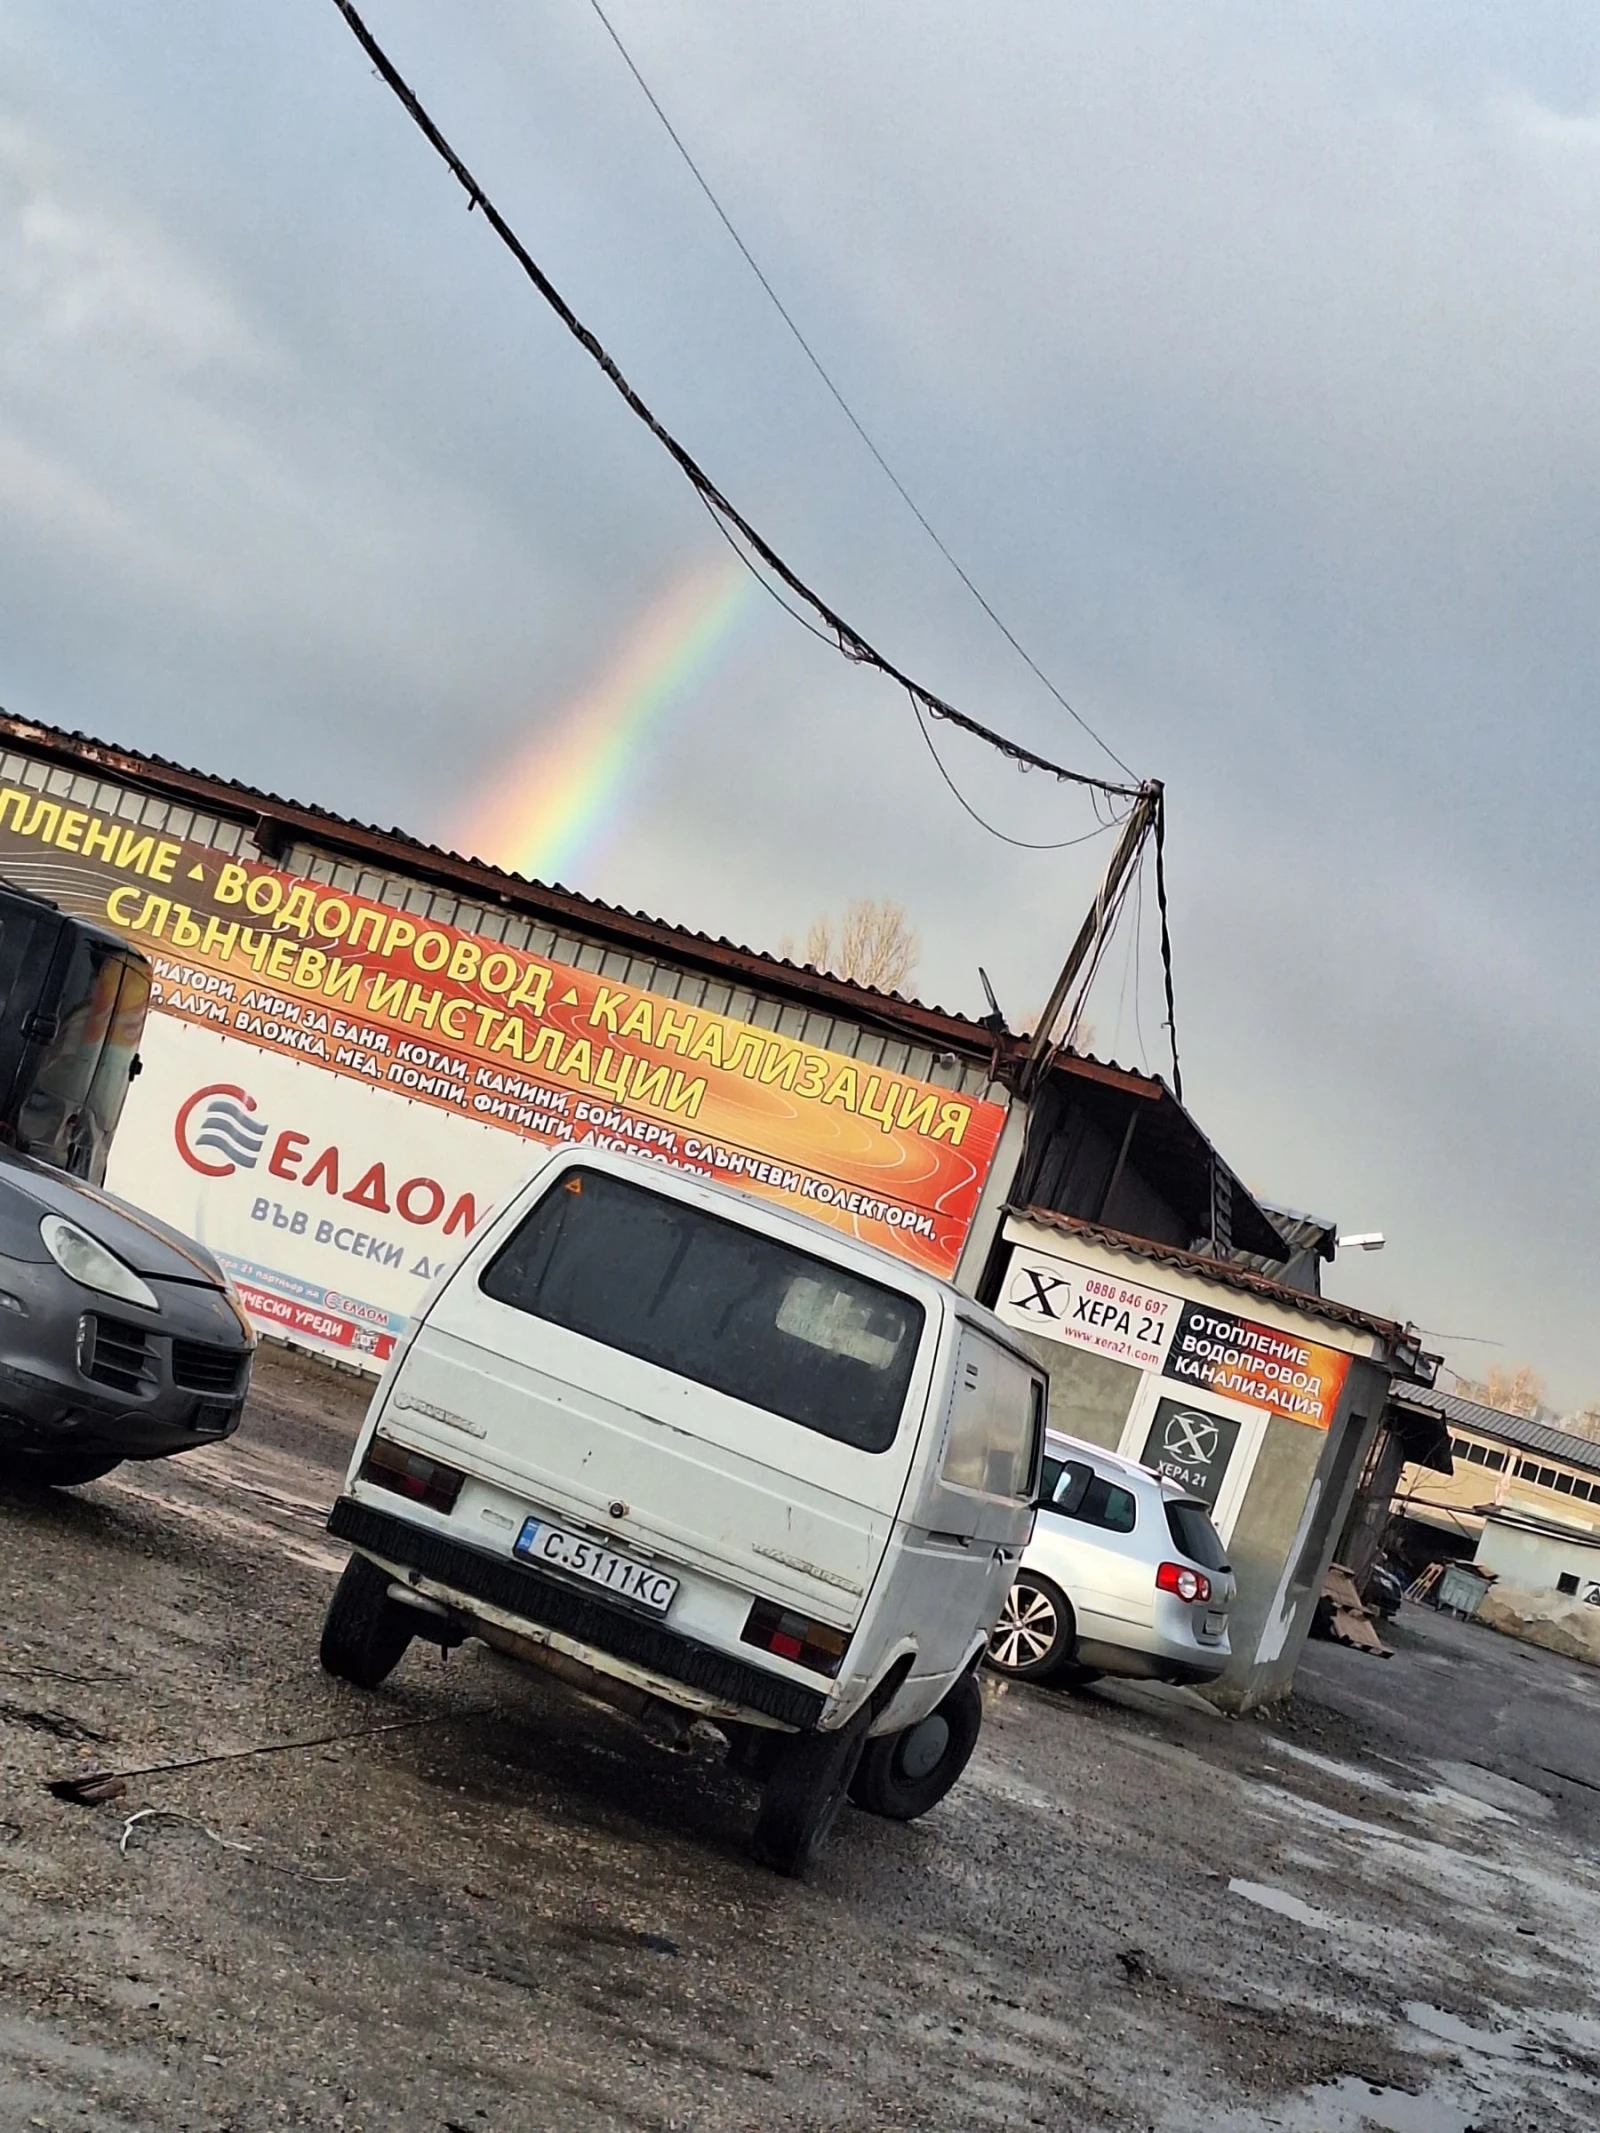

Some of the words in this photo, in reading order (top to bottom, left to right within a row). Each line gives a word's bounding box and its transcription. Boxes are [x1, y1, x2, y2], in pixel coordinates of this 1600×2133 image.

[106, 886, 364, 1003] СЛЪНЧЕВИ
[367, 971, 708, 1119] ИНСТАЛАЦИИ
[213, 863, 553, 1018] ВОДОПРОВОД
[587, 985, 973, 1146] КАНАЛИЗАЦИЯ
[235, 1012, 331, 1061] ВЛОЖКА,
[335, 1046, 382, 1079] МЕД,
[387, 1063, 468, 1108] ПОМПИ,
[241, 990, 302, 1023] ЛИРИ
[302, 1008, 328, 1034] ЗА
[331, 1019, 392, 1057] БАНЯ,
[396, 1041, 471, 1083] КОТЛИ,
[475, 1067, 570, 1117] КАМИНИ,
[575, 1101, 679, 1154] БОЙЛЕРИ,
[684, 1138, 801, 1192] СЛЪНЧЕВИ
[800, 1177, 938, 1241] КОЛЕКТОРИ,
[251, 1197, 309, 1236] ВЪВ
[315, 1219, 404, 1269] ВСЕКИ
[295, 1308, 344, 1338] УРЕДИ
[342, 1299, 389, 1326] ЕЛДОМ
[1072, 1295, 1131, 1336] ХЕРА
[1136, 1316, 1166, 1347] 21
[1085, 1279, 1117, 1300] 0888
[1118, 1290, 1143, 1309] 846
[1144, 1299, 1169, 1316] 697
[1064, 1325, 1160, 1365] www.xera21.com
[1181, 1335, 1322, 1397] ВОДОПРОВОД
[1189, 1314, 1312, 1367] ОТОПЛЕНИЕ
[1174, 1355, 1324, 1419] КАНАЛИЗАЦИЯ
[1191, 1473, 1207, 1488] 21
